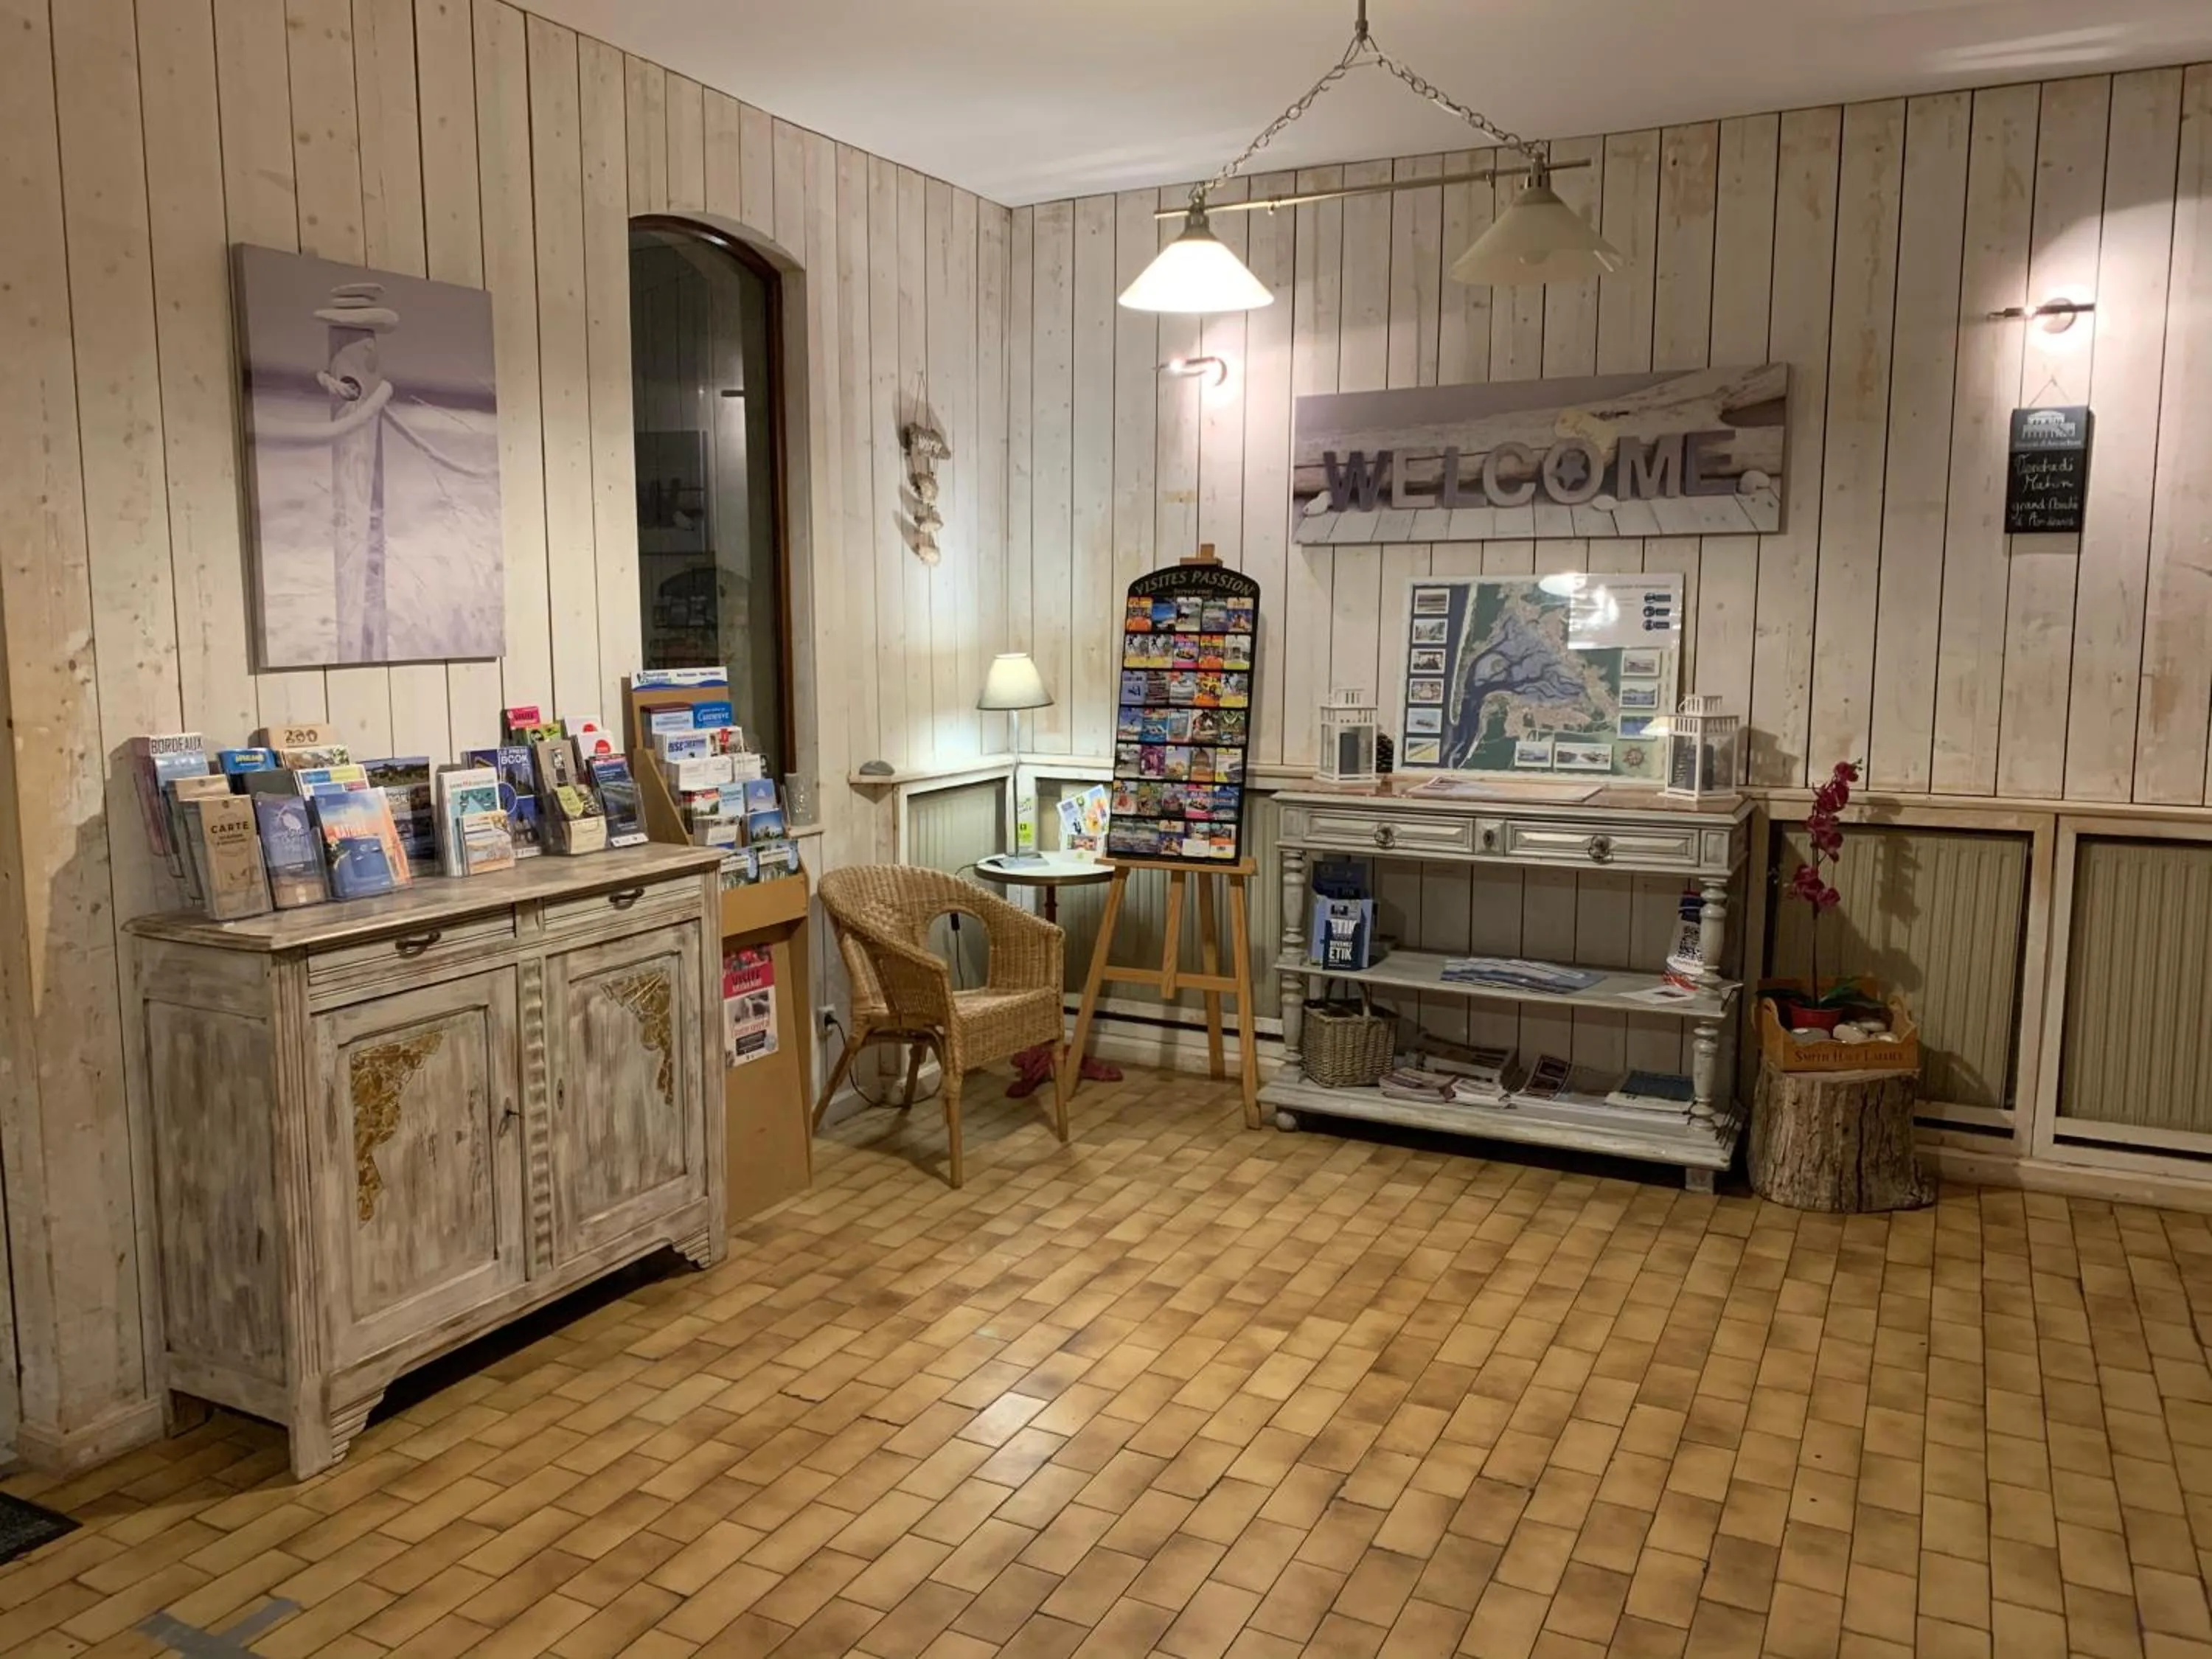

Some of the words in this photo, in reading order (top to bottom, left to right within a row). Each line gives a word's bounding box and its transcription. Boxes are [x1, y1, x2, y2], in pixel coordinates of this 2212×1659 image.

[1323, 429, 1736, 512] WELCOME
[1135, 570, 1187, 594] VISITES
[1191, 570, 1255, 596] PASSION
[150, 737, 203, 754] BORDEAUX
[210, 821, 249, 834] CARTE
